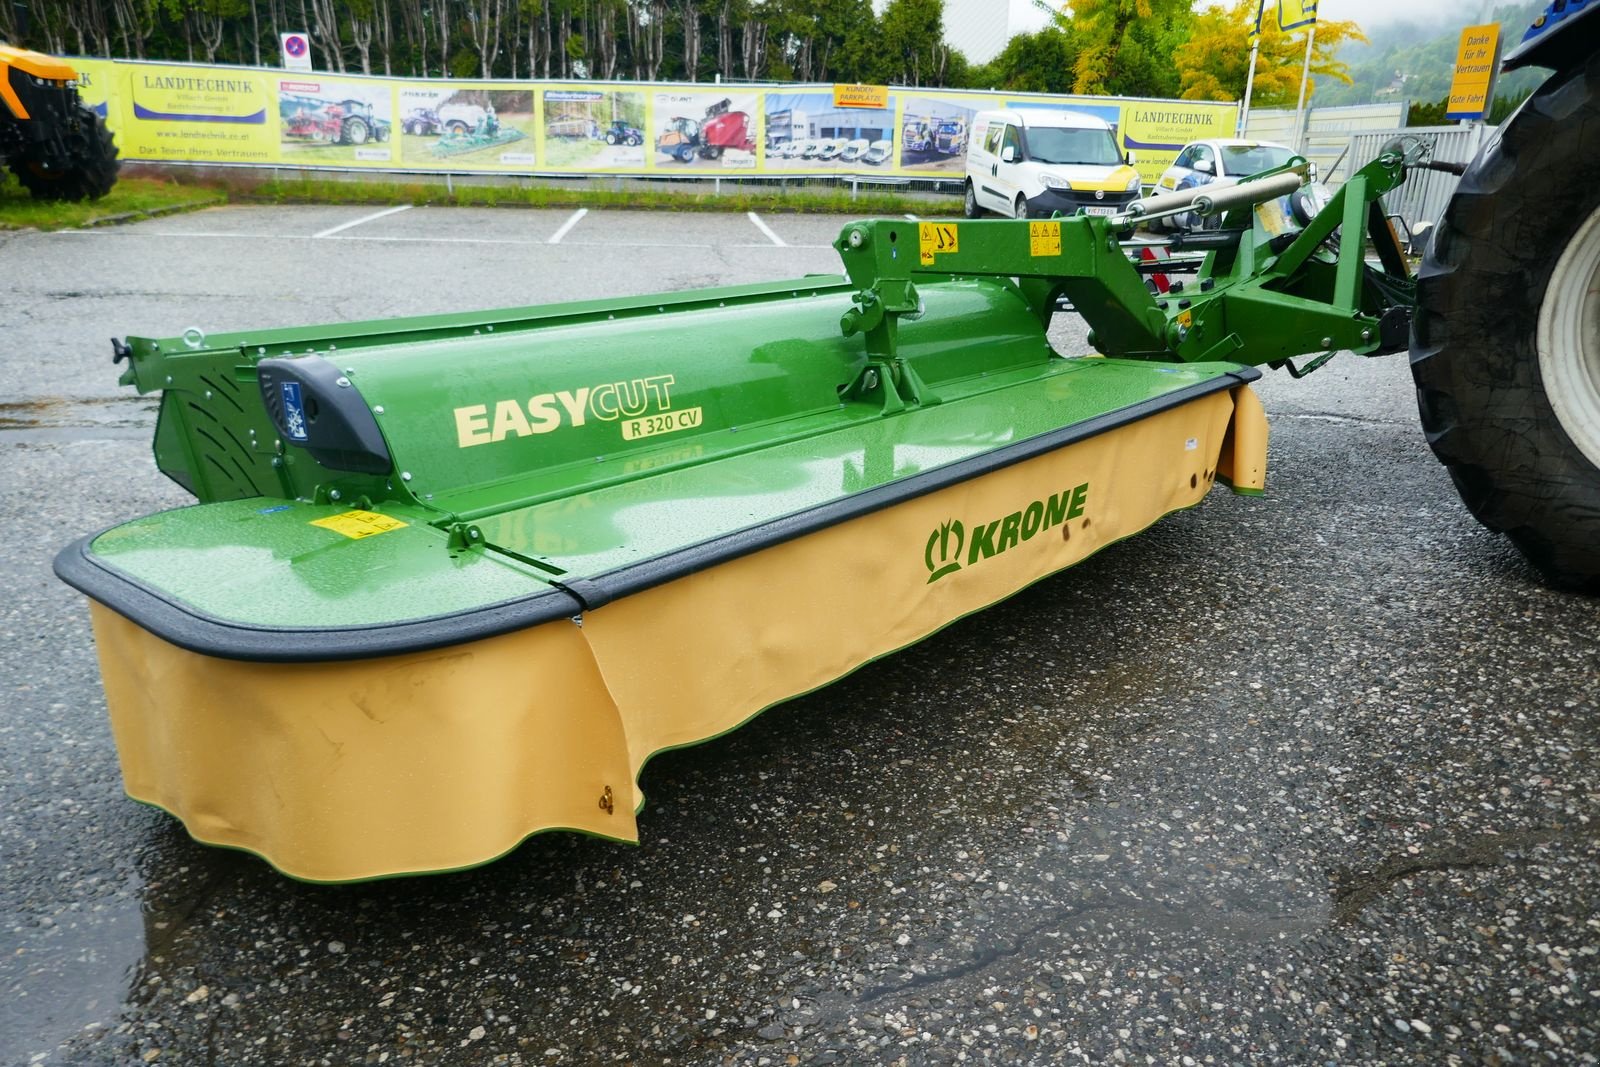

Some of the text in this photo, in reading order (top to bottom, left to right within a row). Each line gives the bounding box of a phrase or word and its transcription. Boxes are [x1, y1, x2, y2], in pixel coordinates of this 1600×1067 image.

[1467, 35, 1490, 46] Danke
[1464, 48, 1487, 60] für Ihr
[1456, 64, 1491, 74] Vertrauen
[144, 76, 253, 94] LANDTECHNIK
[1450, 94, 1484, 104] Gute Fahrt
[1134, 111, 1214, 125] LANDTECHNIK
[160, 147, 186, 156] Team
[453, 374, 675, 448] EASYCUT
[631, 411, 698, 437] R 320 CV
[967, 482, 1089, 566] KRONE
